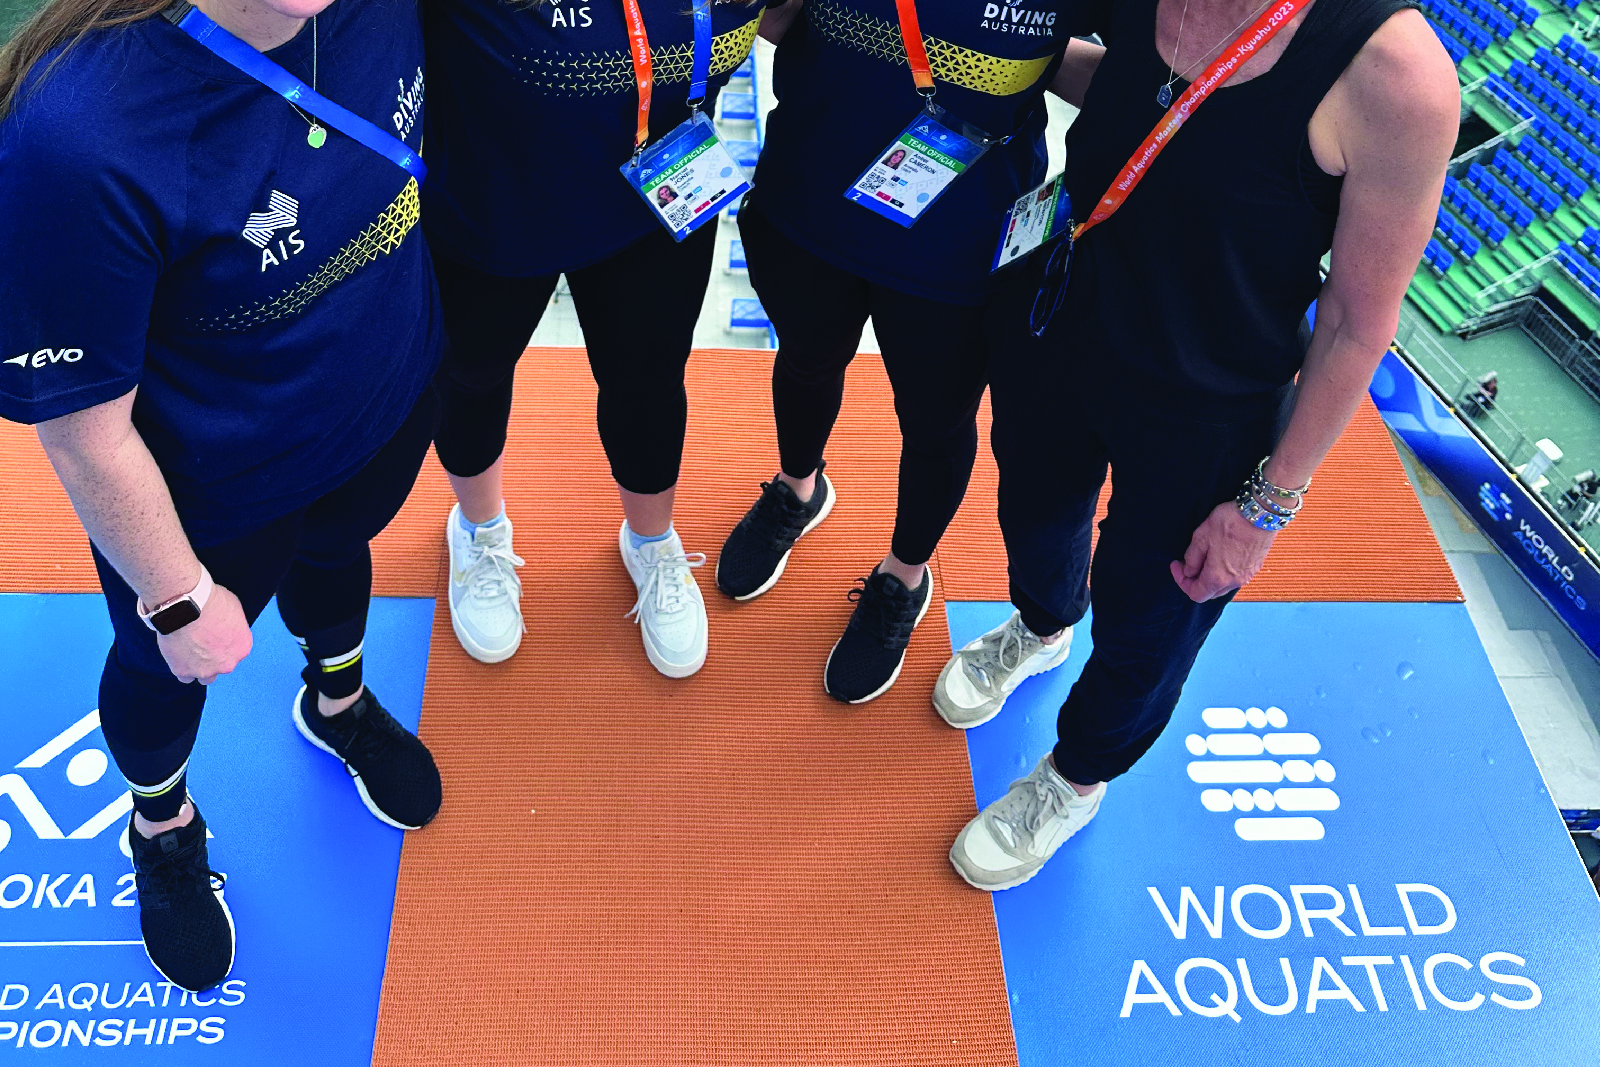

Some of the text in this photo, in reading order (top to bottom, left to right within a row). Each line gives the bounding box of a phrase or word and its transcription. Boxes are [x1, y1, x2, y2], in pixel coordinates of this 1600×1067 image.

[551, 7, 593, 28] AIS
[981, 19, 1053, 36] AUSTRALIA
[983, 0, 1057, 26] DIVING
[636, 38, 647, 66] World
[393, 65, 423, 130] DIVING
[1117, 171, 1136, 191] World
[1132, 142, 1158, 173] Aquatics
[1155, 112, 1183, 143] Masters
[1268, 1, 1295, 27] 2023
[650, 168, 674, 187] TEAM
[674, 144, 711, 170] OFFICIAL
[907, 138, 929, 152] TEAM
[927, 148, 957, 169] OFFICIAL
[674, 168, 695, 185] JONES
[852, 193, 863, 201] 2
[684, 226, 693, 235] 2
[262, 229, 304, 272] AIS
[1519, 518, 1574, 582] WORLD
[1512, 530, 1587, 611] AQUATICS
[1146, 883, 1458, 939] WORLD
[1119, 951, 1542, 1023] AQUATICS
